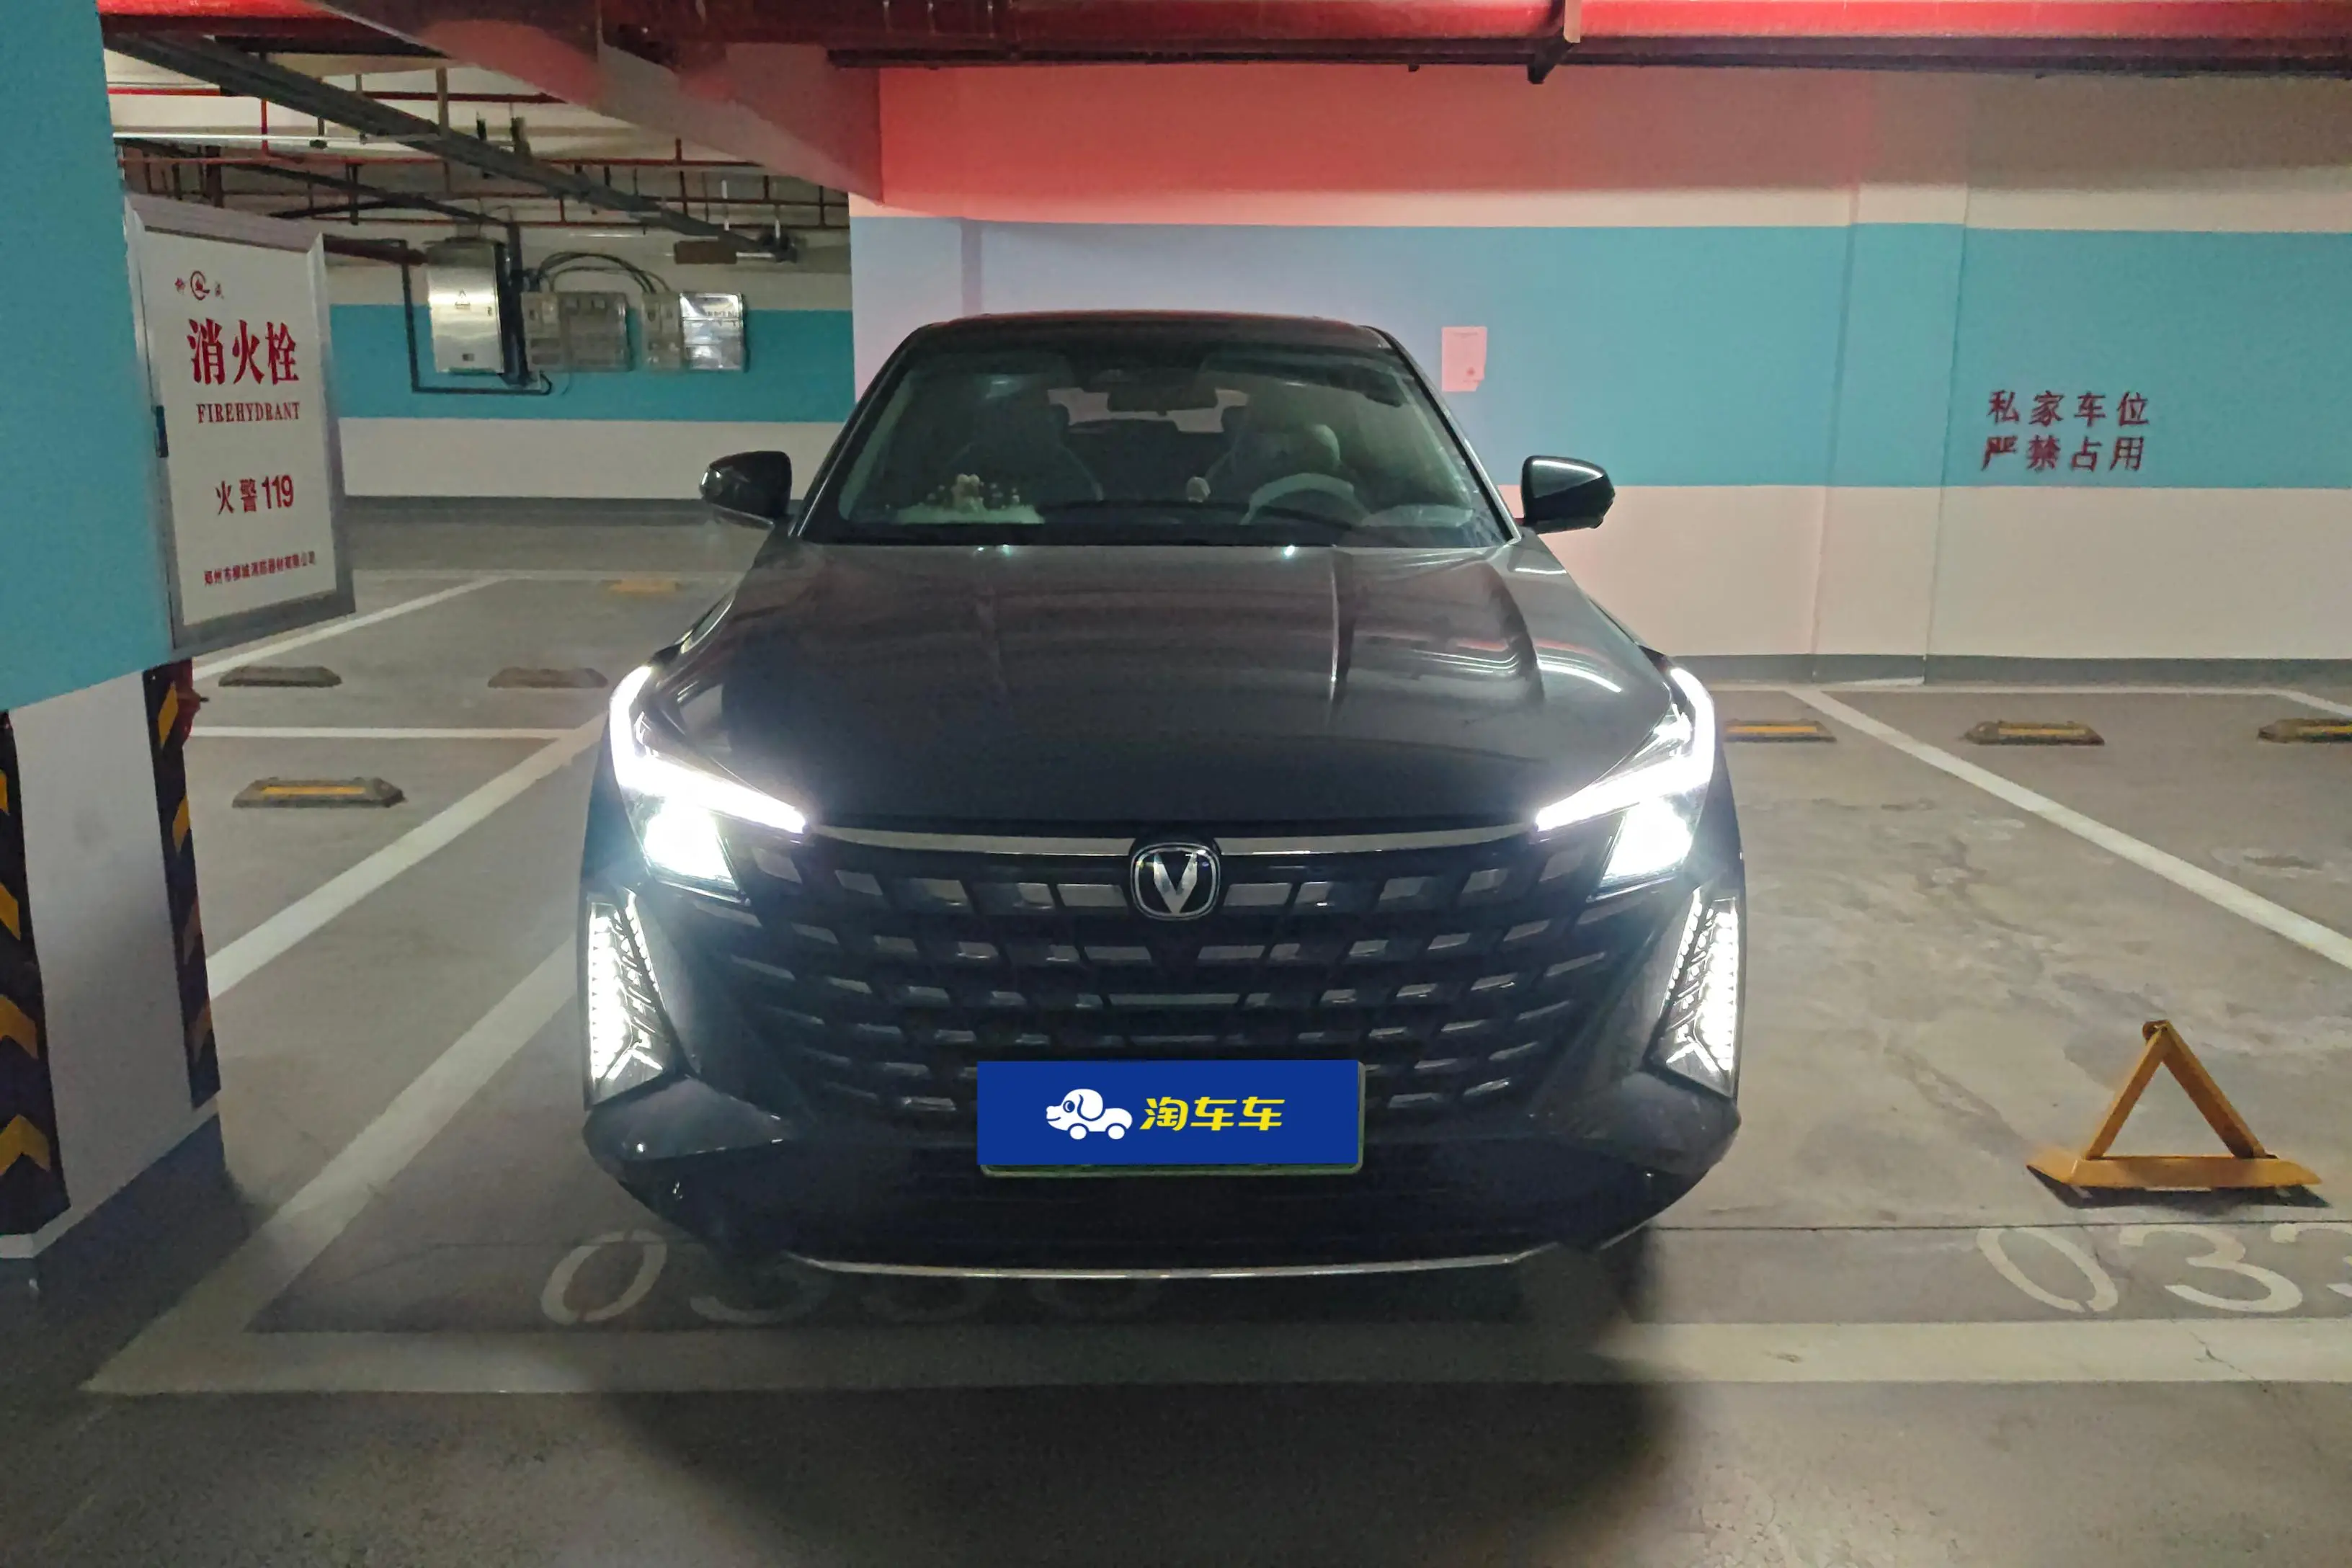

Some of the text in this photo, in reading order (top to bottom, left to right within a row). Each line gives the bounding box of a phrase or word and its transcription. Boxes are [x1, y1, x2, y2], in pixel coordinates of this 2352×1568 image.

[187, 318, 299, 386] 消火栓
[197, 401, 300, 424] FIREHYDRANT
[1987, 390, 2150, 428] 私家车位
[1981, 435, 2144, 472] 严禁占用
[215, 474, 295, 515] 火警119
